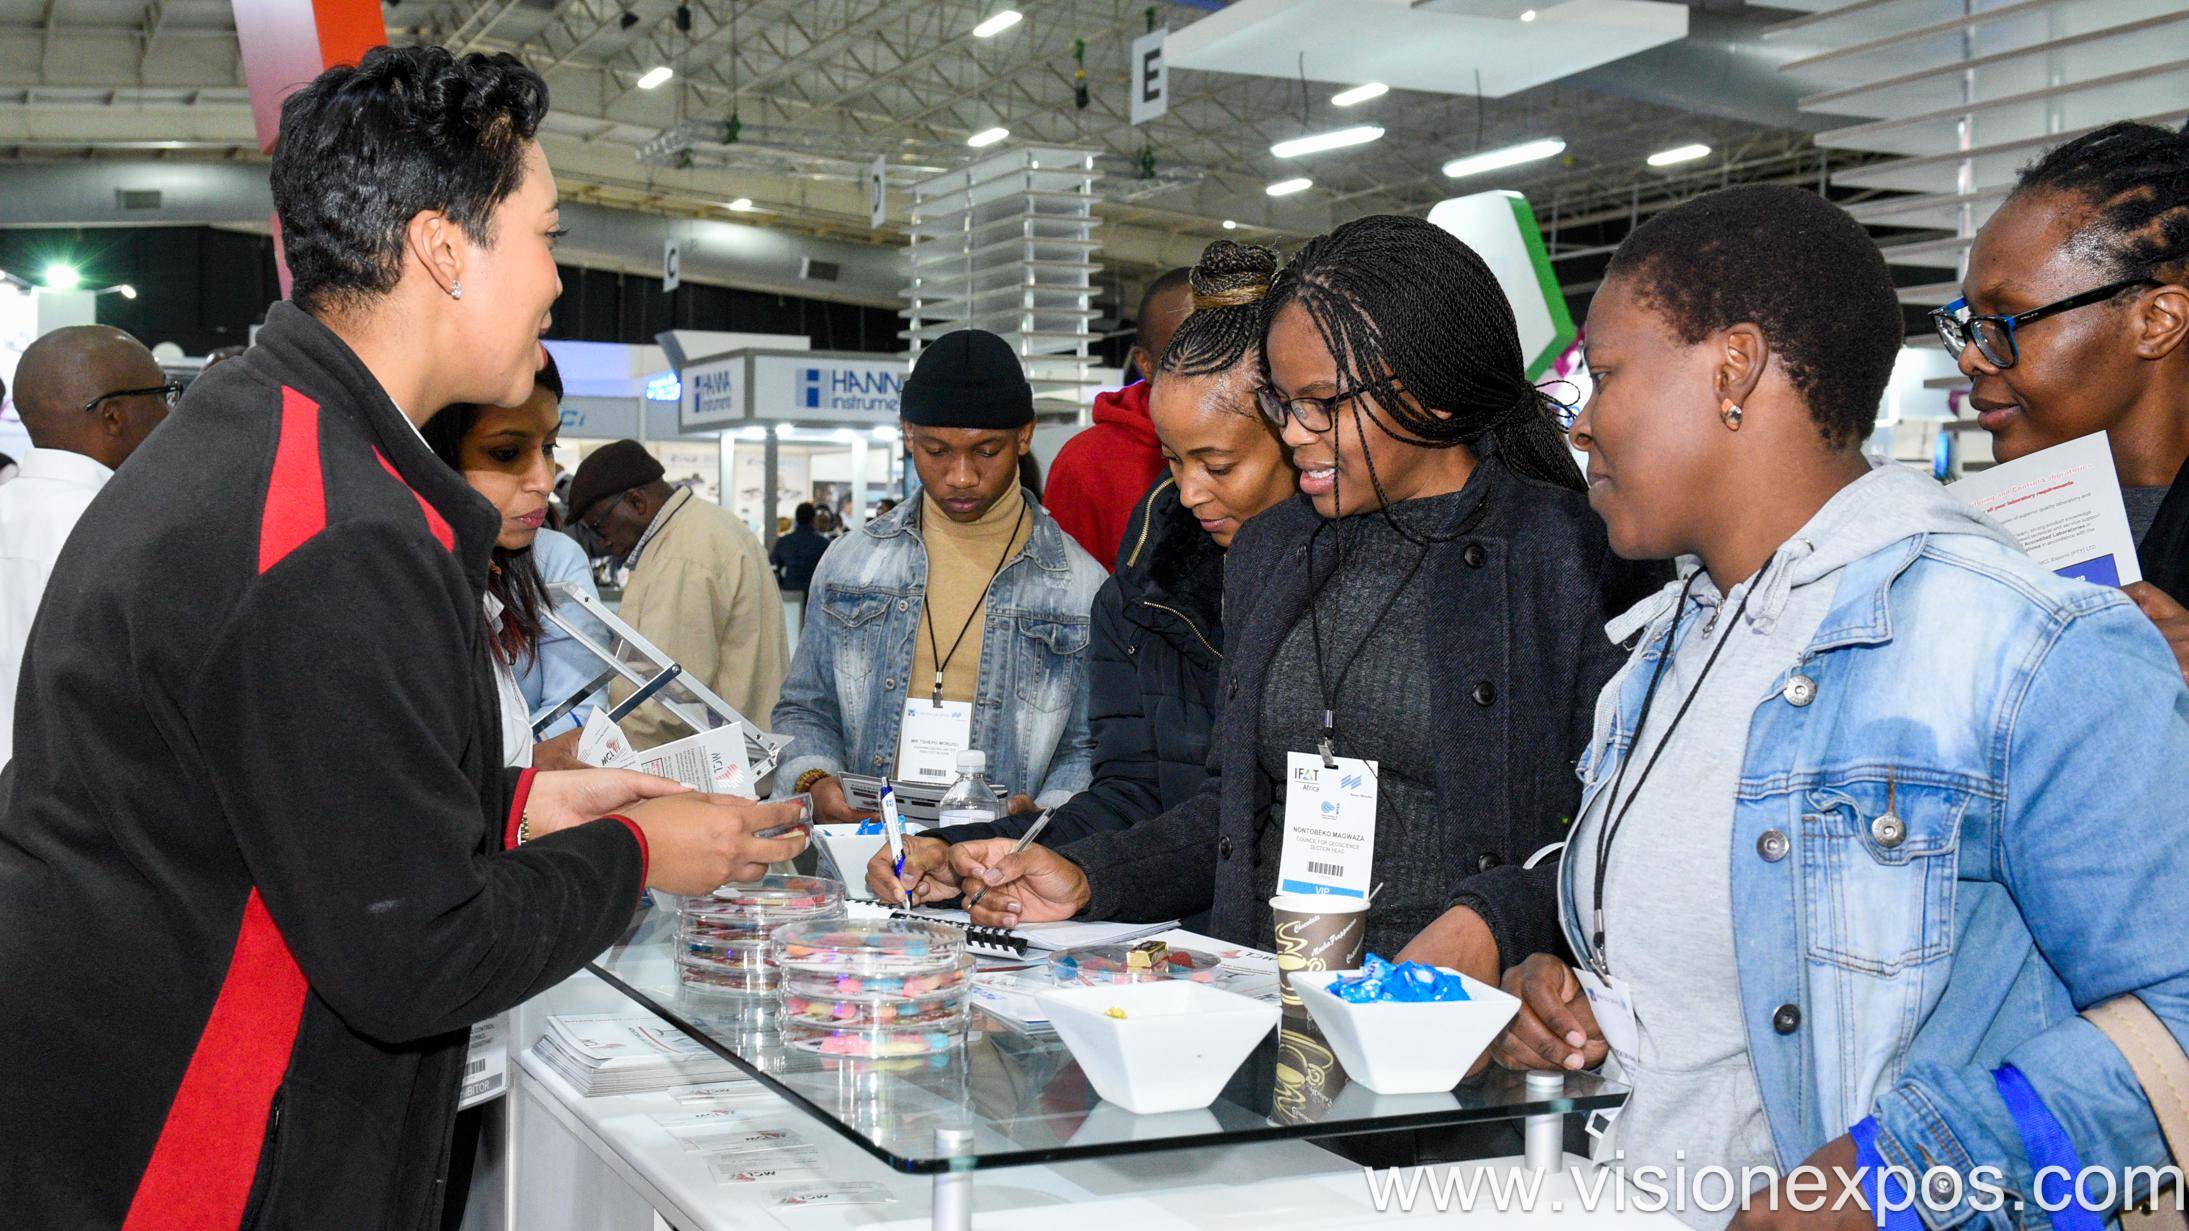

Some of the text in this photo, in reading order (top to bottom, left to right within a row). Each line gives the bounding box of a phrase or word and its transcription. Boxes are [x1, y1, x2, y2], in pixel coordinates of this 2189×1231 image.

[1143, 48, 1160, 103] E
[667, 248, 676, 278] C
[711, 752, 723, 774] MCL
[1294, 767, 1319, 781] IFAT
[1303, 784, 1320, 792] Africa
[1293, 826, 1365, 842] NONTOBEKO MAGWAZA
[1315, 886, 1330, 895] VIP
